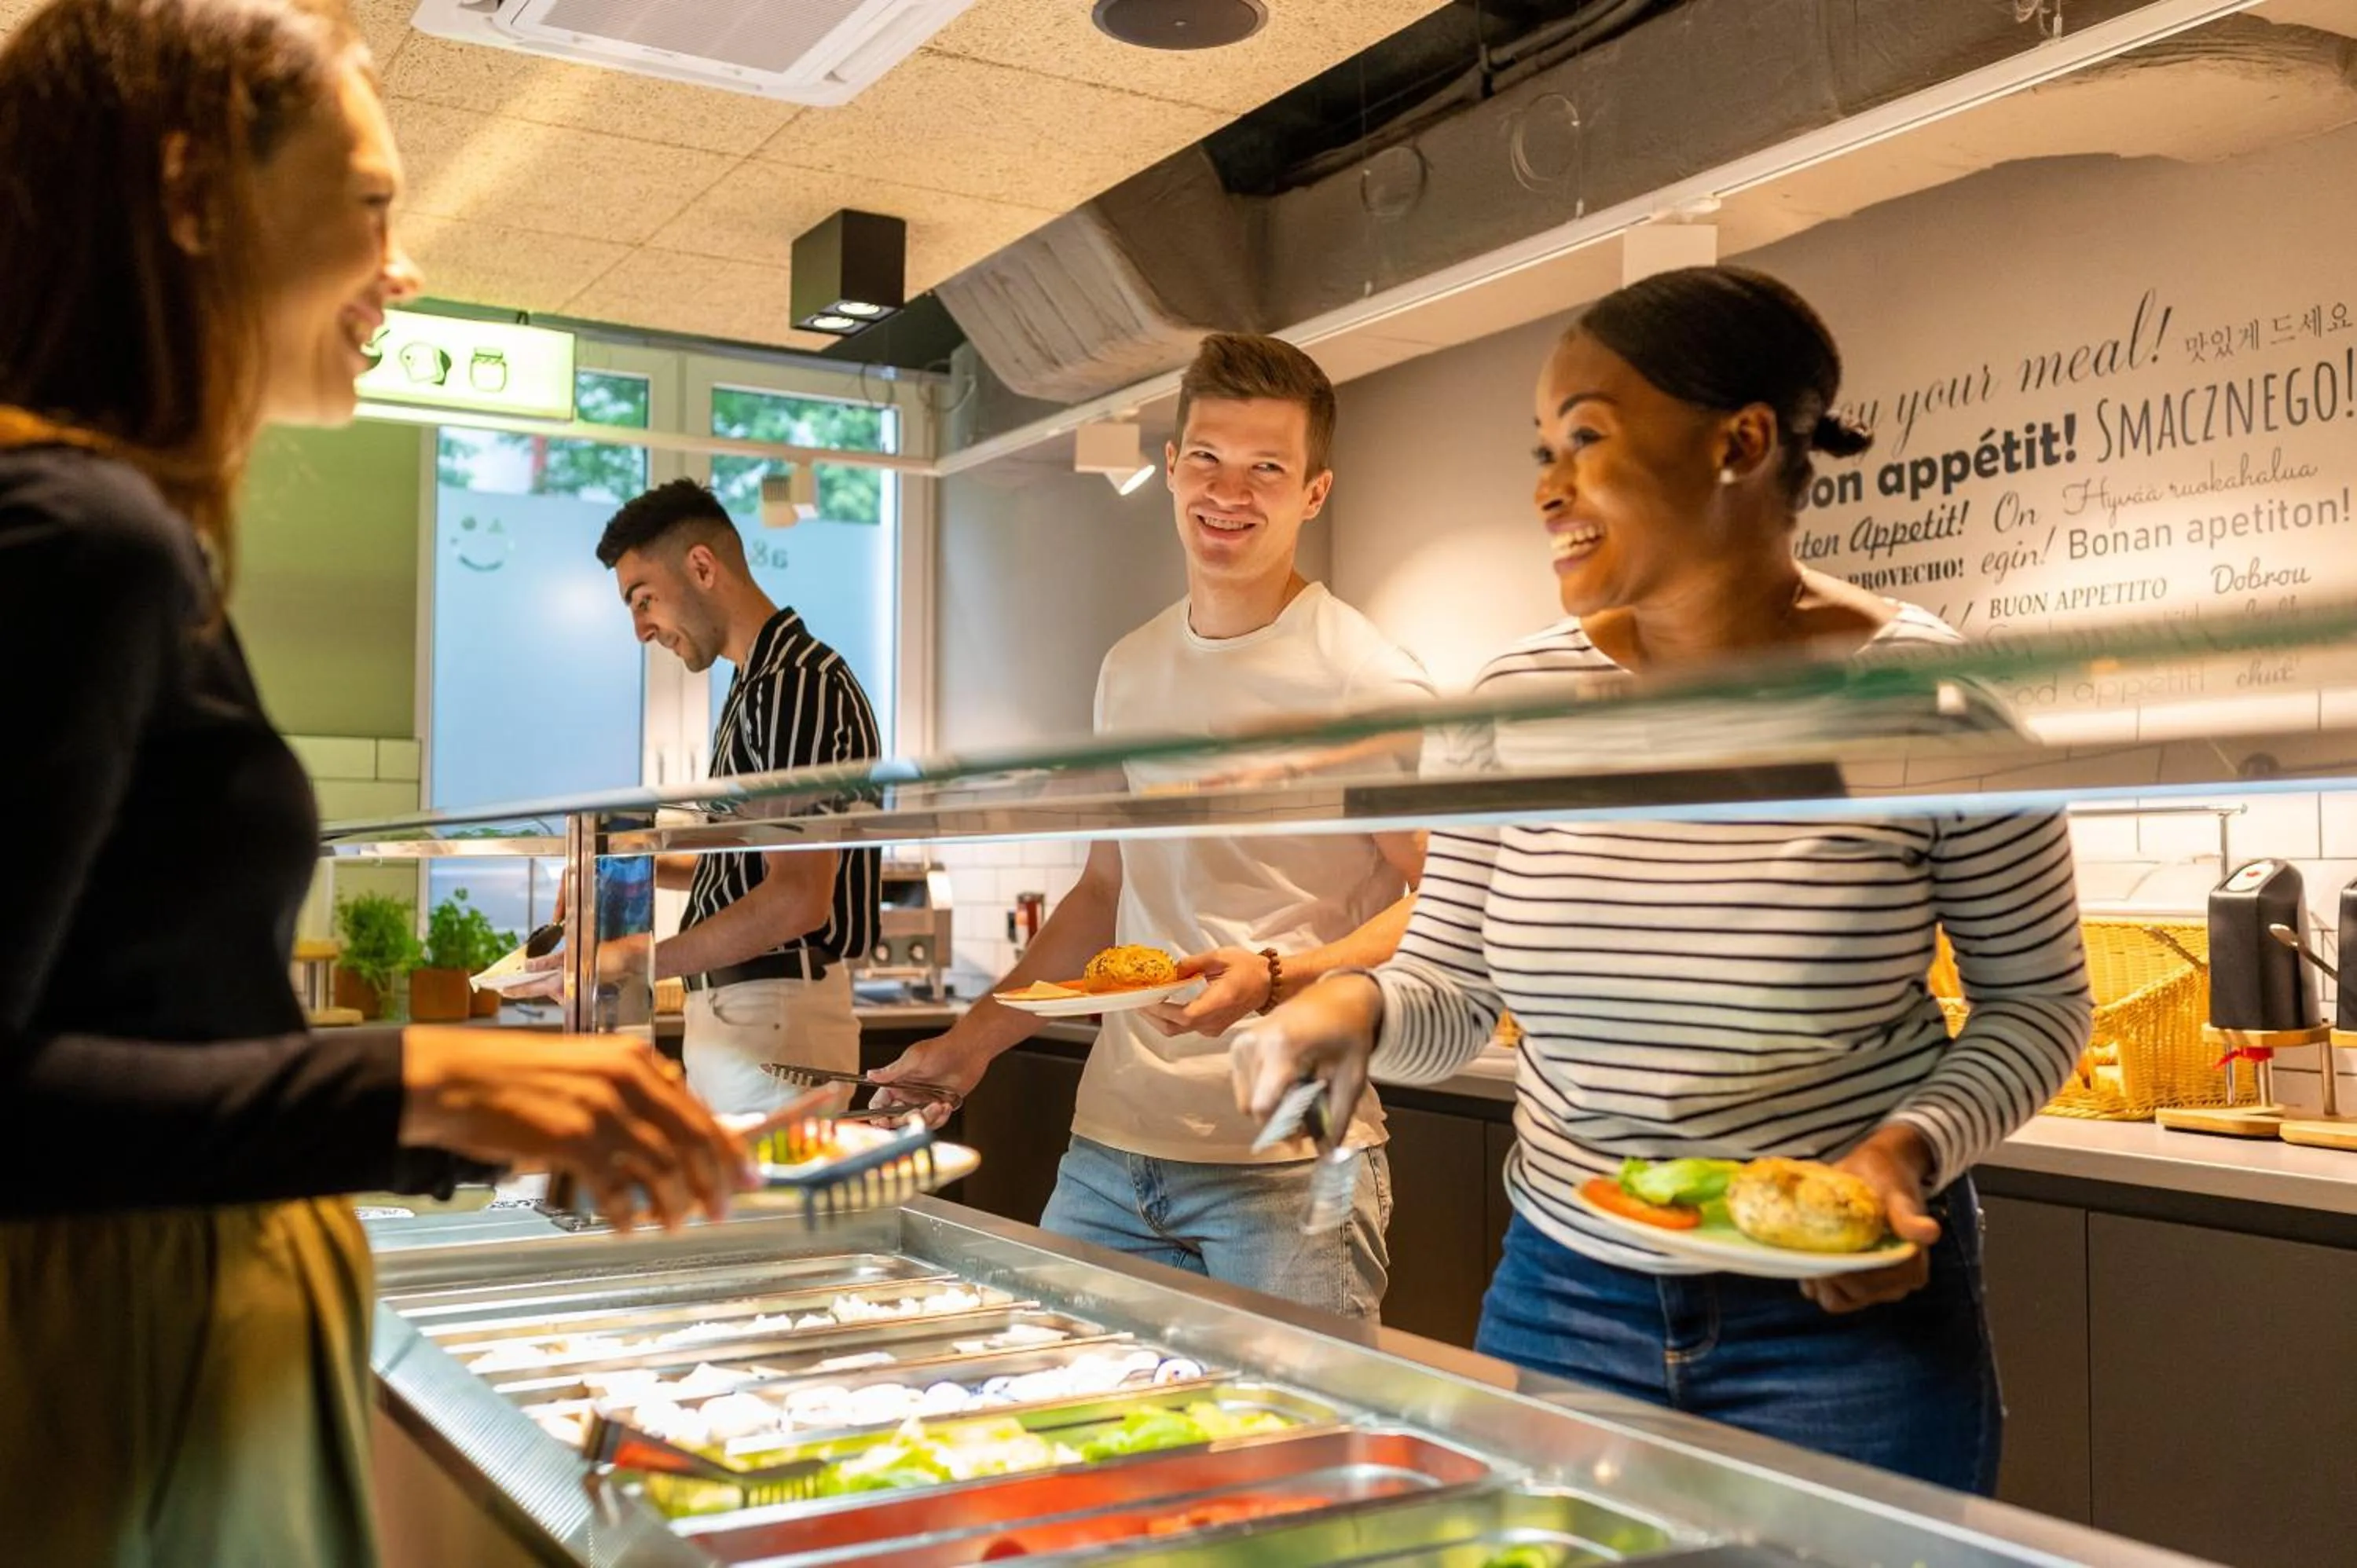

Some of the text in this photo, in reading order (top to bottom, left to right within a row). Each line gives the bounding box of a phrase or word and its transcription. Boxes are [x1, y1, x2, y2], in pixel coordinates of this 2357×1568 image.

[2186, 302, 2354, 363] 맛있게 드세요
[1891, 364, 2000, 459] your
[2017, 287, 2173, 393] meal!
[2096, 346, 2355, 463] SMACZNEGO!
[1811, 412, 2077, 509] on appétit!
[2062, 445, 2319, 529] Hyvää ruokahalua
[1793, 499, 1970, 561] ten Appetit!
[1994, 490, 2037, 534] On
[2069, 486, 2350, 560] Bonan apetiton!
[1981, 525, 2057, 586] egin!
[2210, 556, 2312, 595] Dobrou
[1989, 592, 2048, 619] BUON
[2055, 577, 2168, 613] APPETITO
